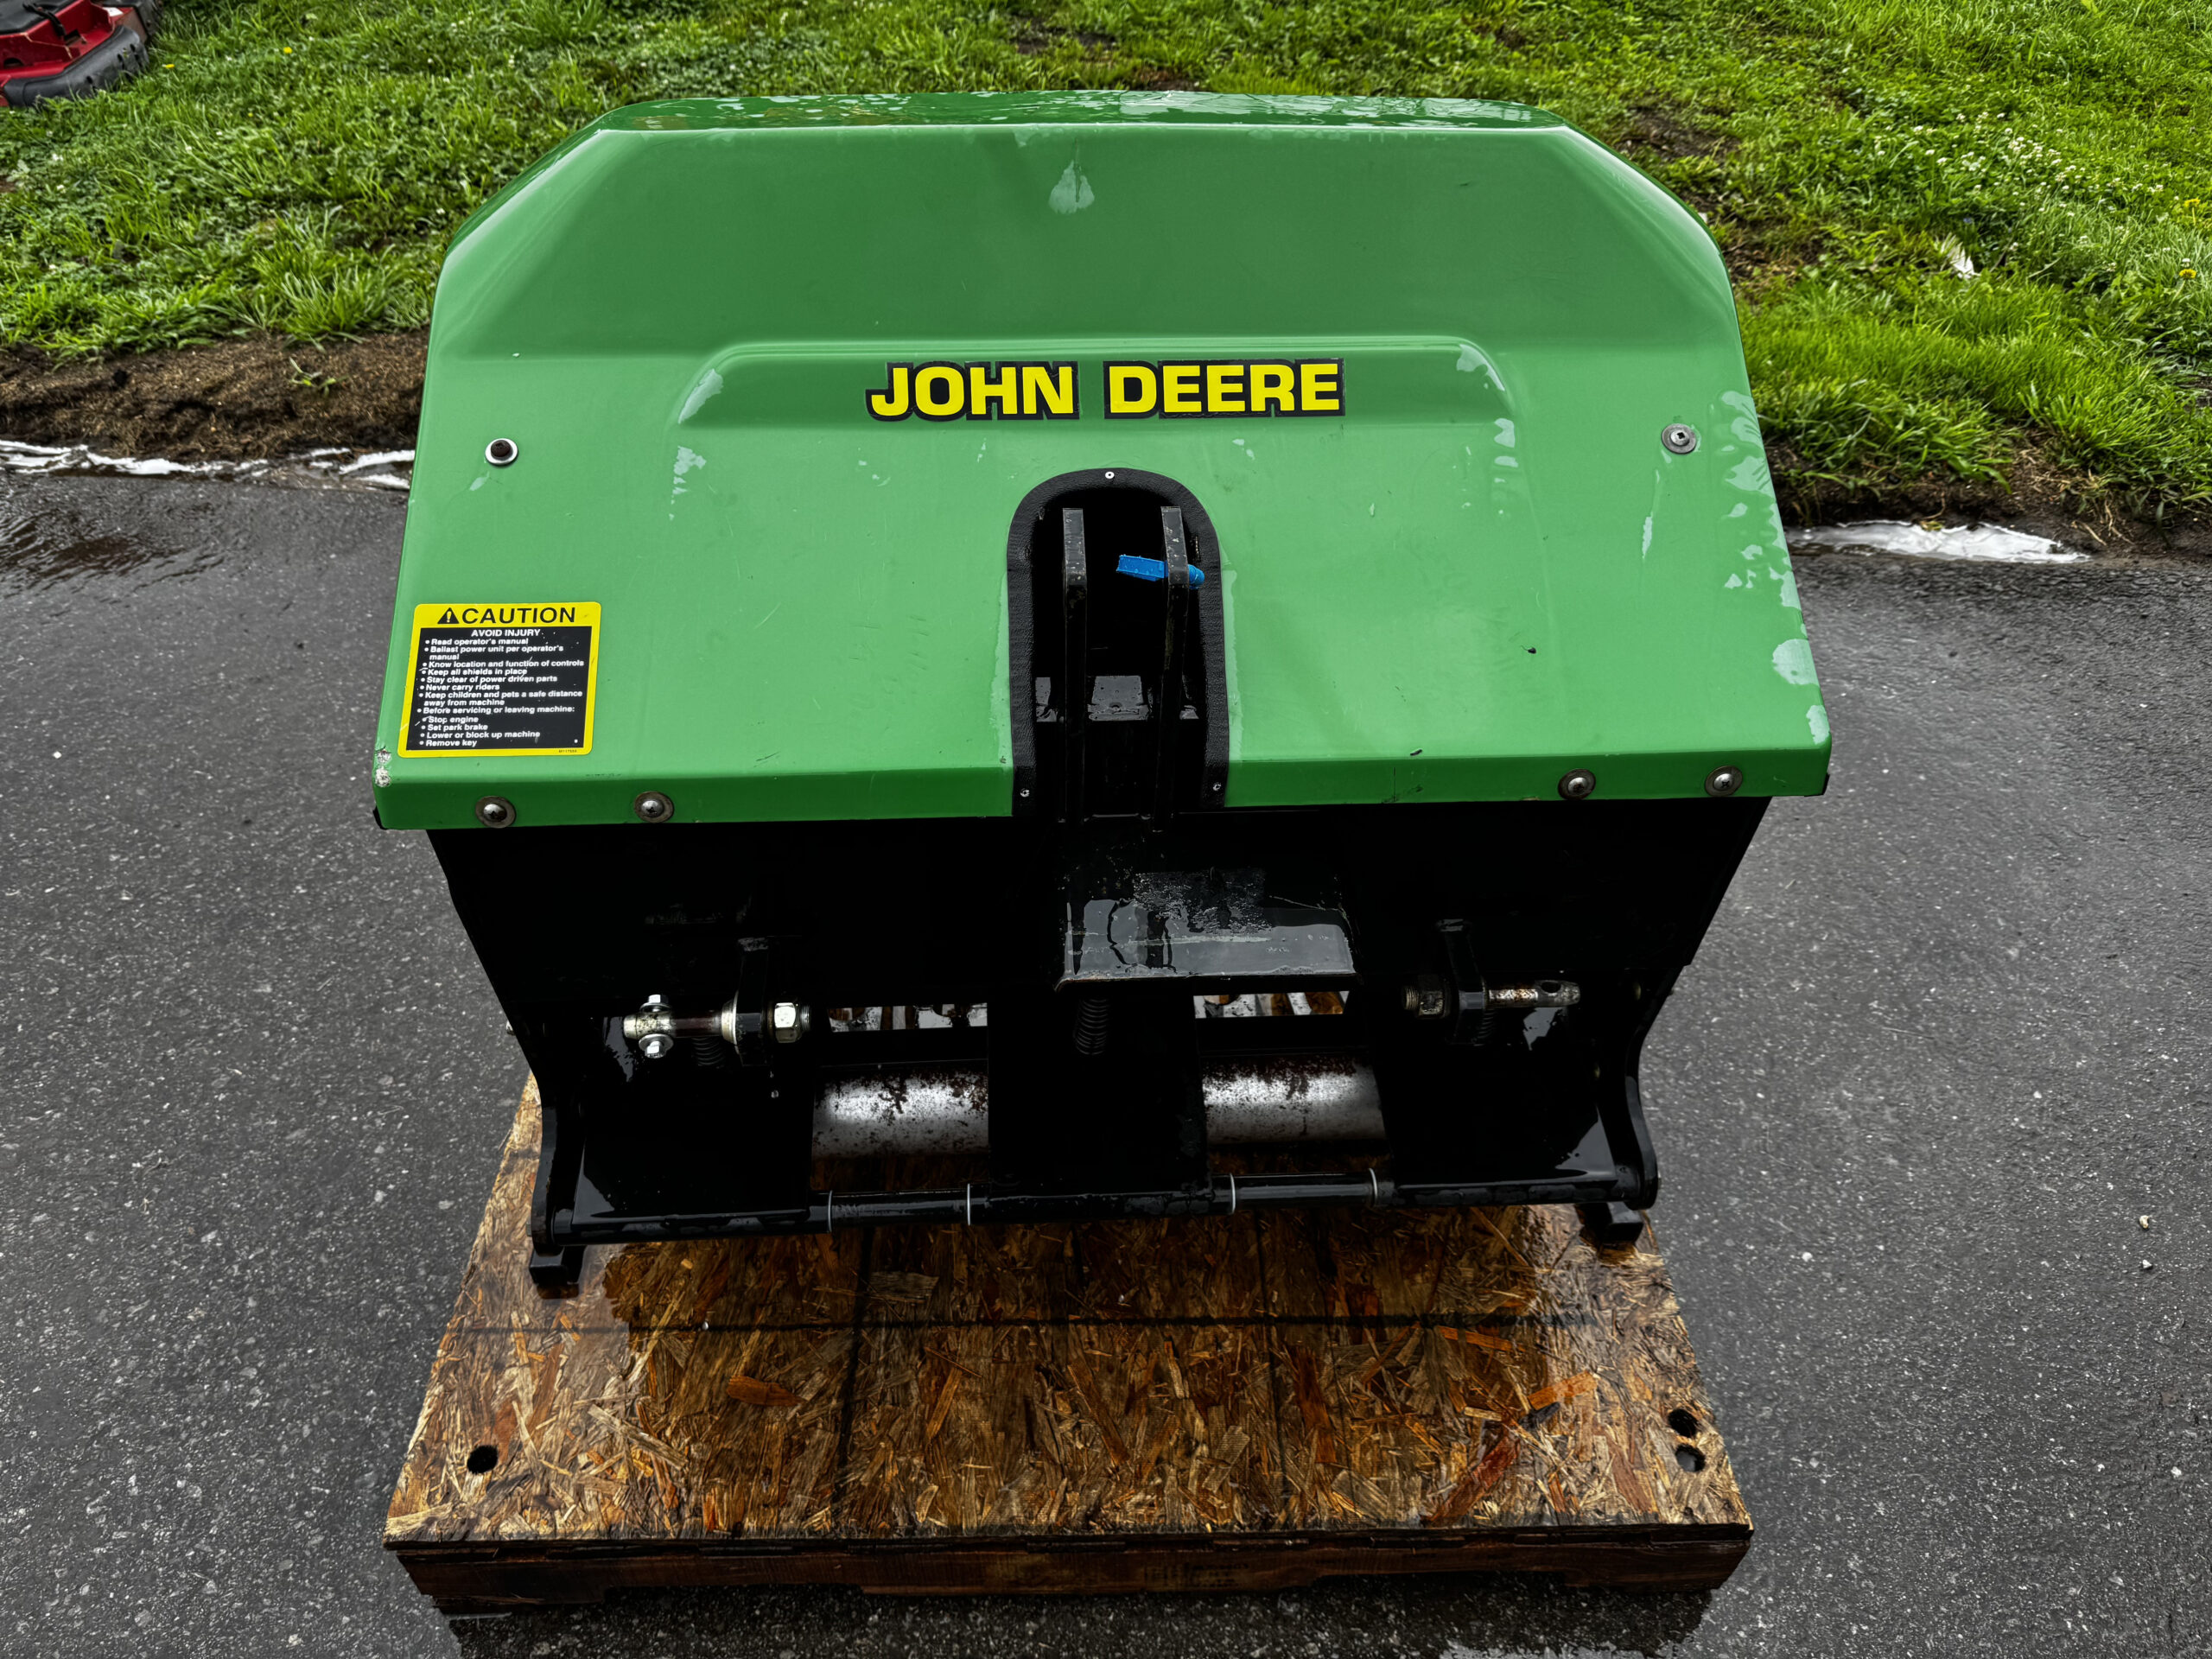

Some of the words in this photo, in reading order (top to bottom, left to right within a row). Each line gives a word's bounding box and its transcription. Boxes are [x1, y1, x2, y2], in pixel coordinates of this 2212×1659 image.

[871, 366, 1073, 416] JOHN
[1110, 364, 1338, 412] DEERE
[462, 607, 575, 624] CAUTION
[505, 706, 535, 715] leaving
